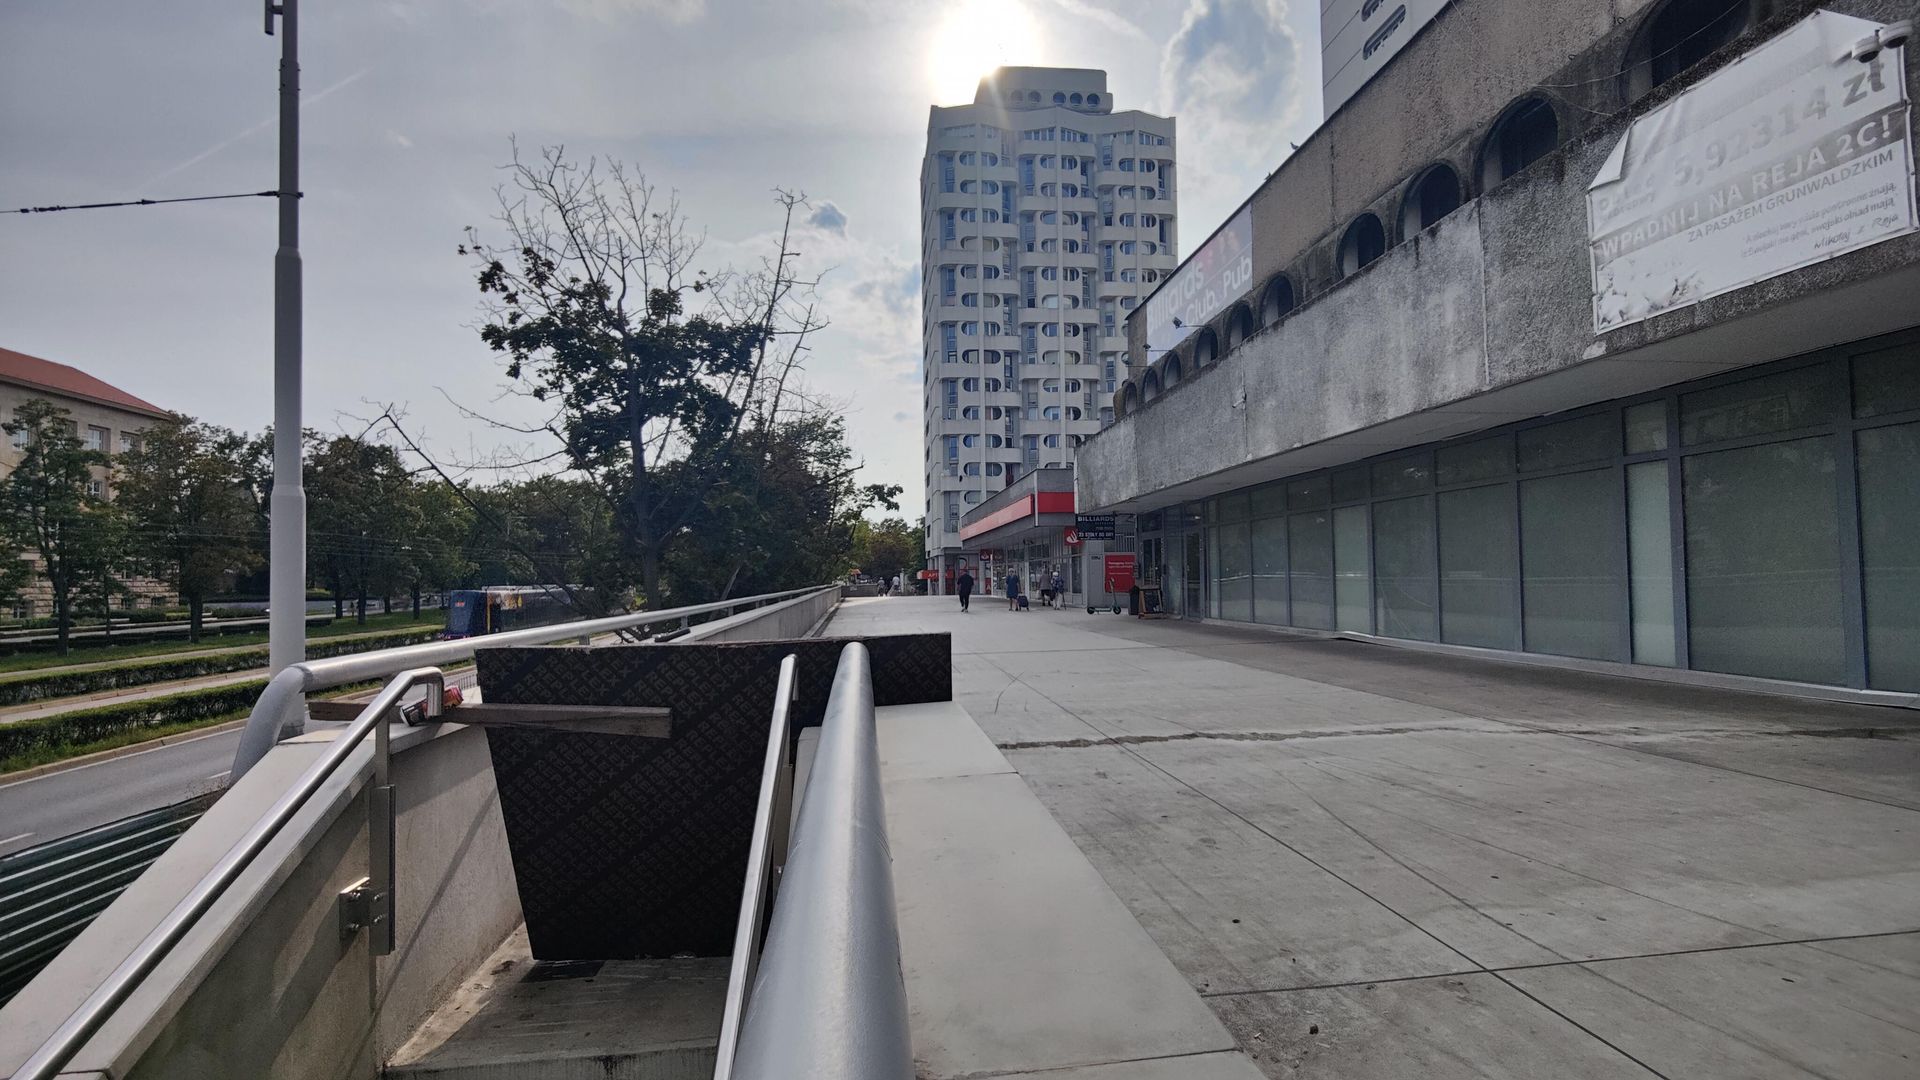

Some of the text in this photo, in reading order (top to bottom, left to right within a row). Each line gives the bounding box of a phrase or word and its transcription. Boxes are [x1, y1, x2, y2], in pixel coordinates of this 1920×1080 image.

[1842, 54, 1886, 109] zł
[1601, 201, 1700, 257] WPADNIJ
[1709, 186, 1745, 213] NA
[1751, 148, 1827, 194] REJA
[1836, 115, 1891, 157] 2C!
[1687, 150, 1894, 243] ZA PASAŻEM GRUNWALDZKIM
[1222, 256, 1251, 298] Pub
